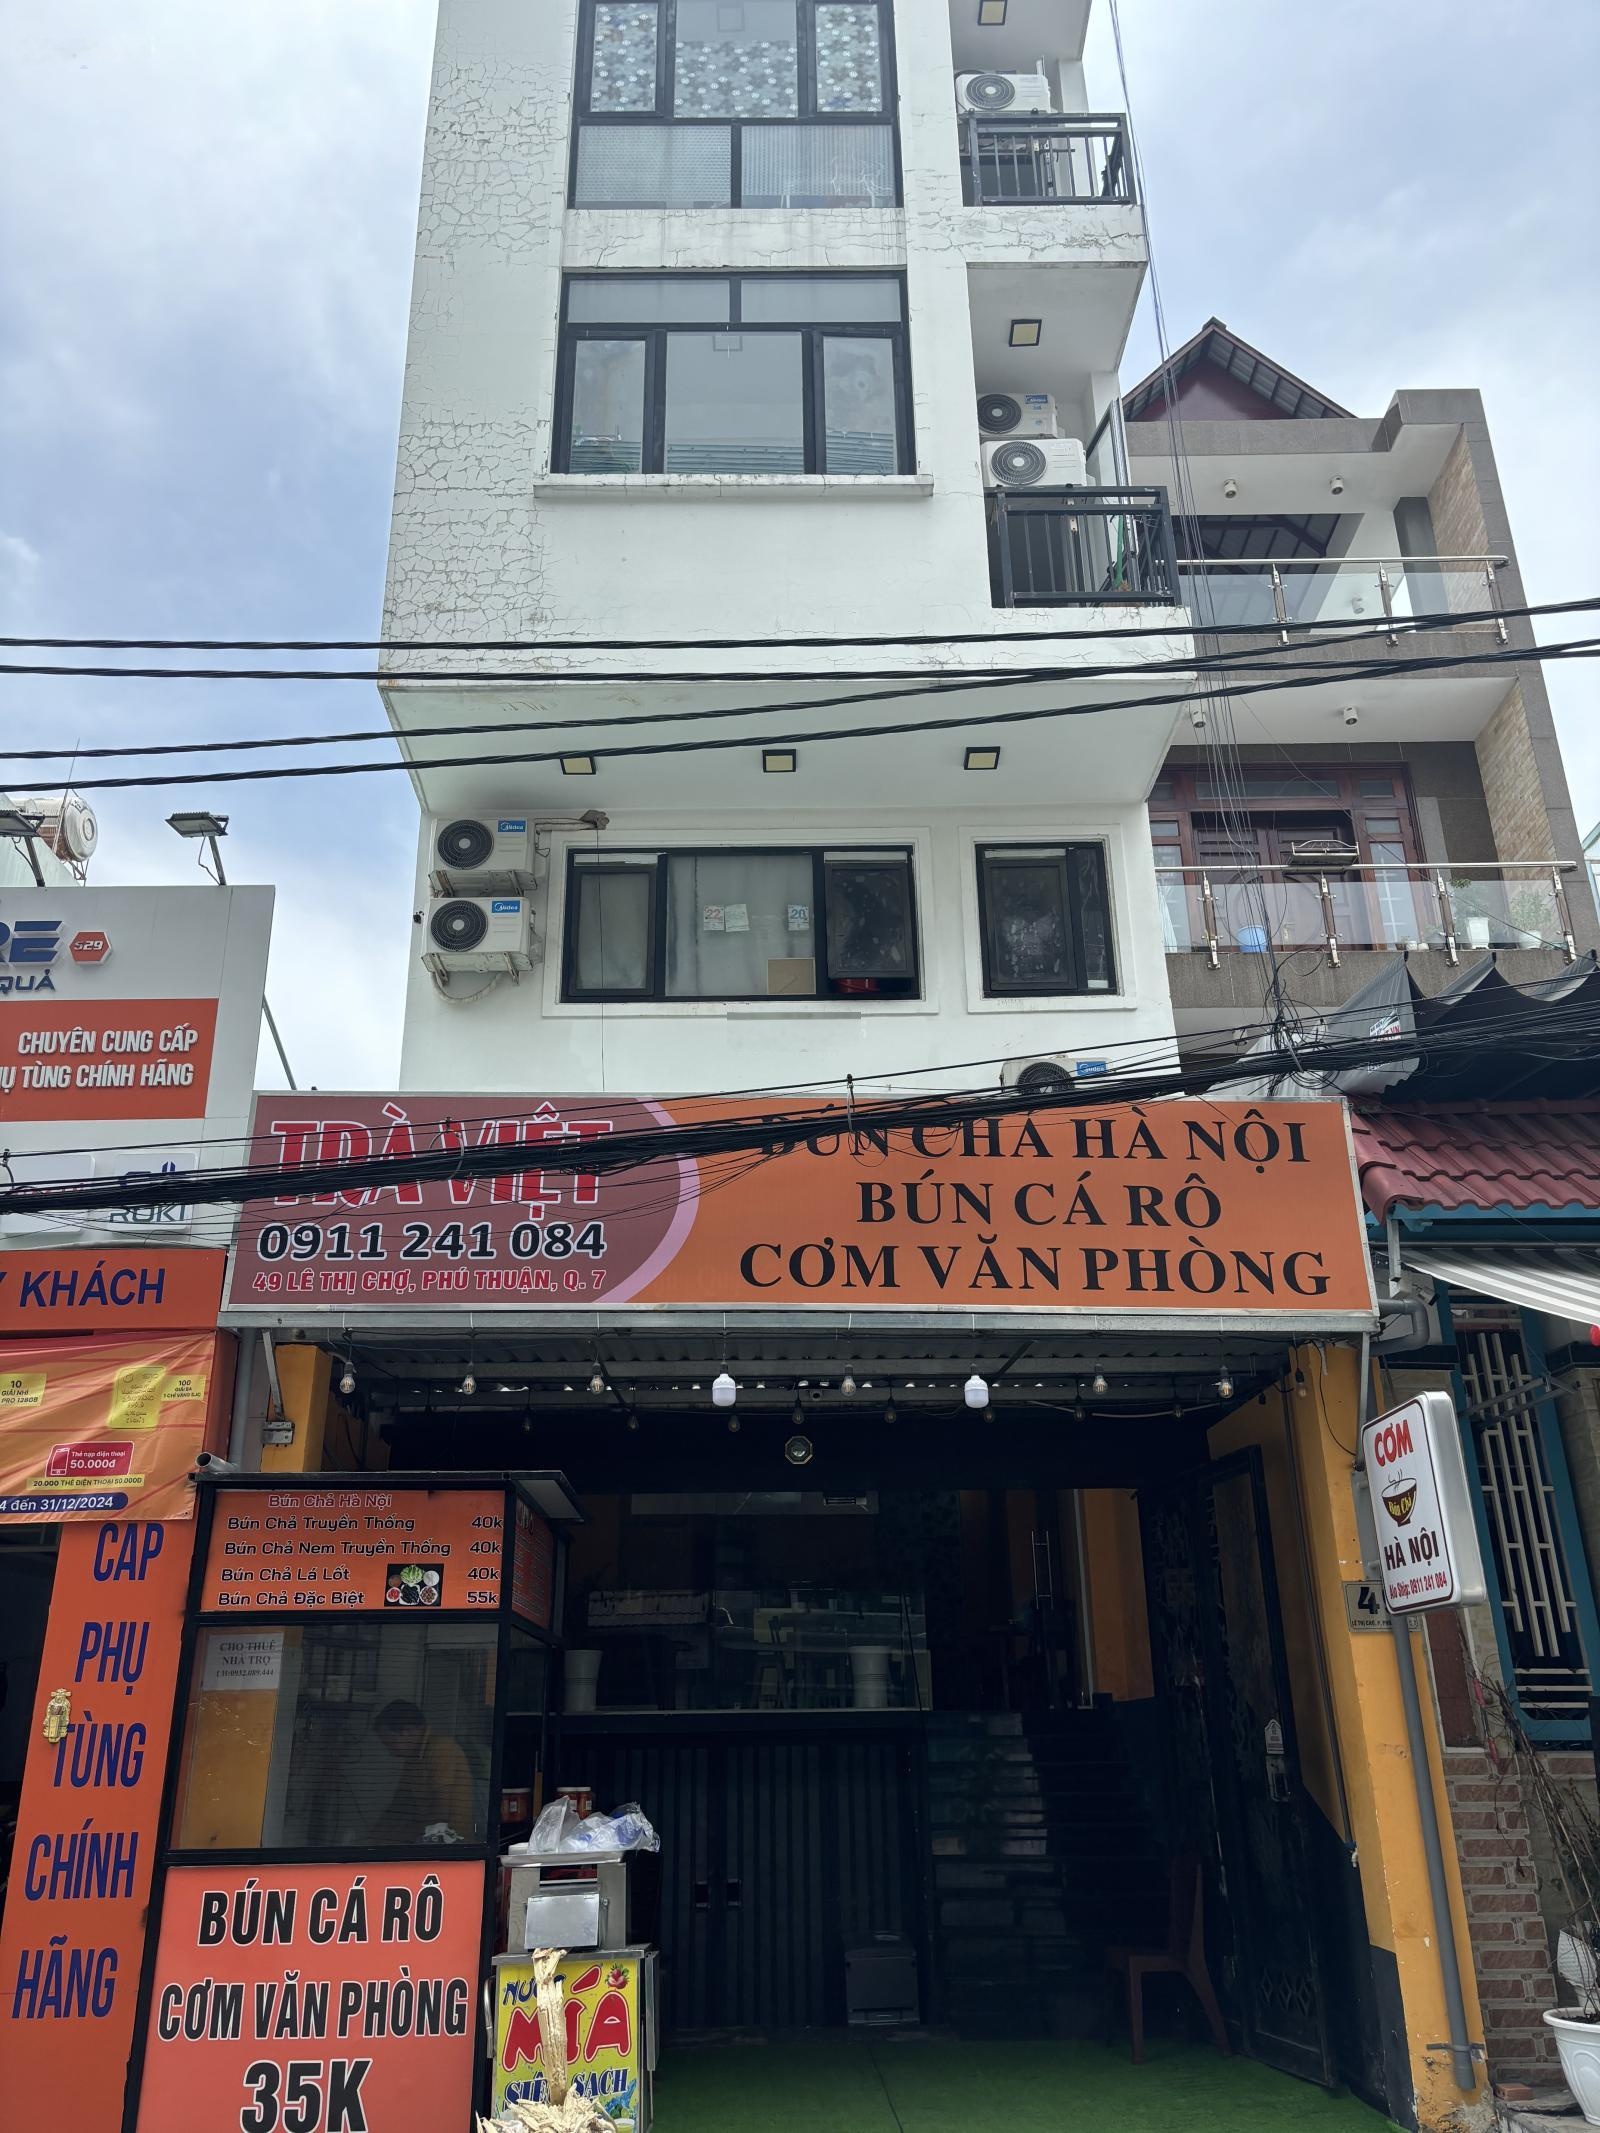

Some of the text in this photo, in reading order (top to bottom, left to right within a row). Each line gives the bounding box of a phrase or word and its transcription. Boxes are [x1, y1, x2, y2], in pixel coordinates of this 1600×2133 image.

[18, 1023, 199, 1054] CHUYÊN CUNG CẤP
[0, 1058, 194, 1093] Ụ TÙNG CHÍNH HÃNG
[1069, 1106, 1168, 1160] HÀ
[1185, 1108, 1312, 1174] NỘI
[271, 1101, 613, 1220] TRÀ VIỆT
[856, 1169, 1221, 1229] BÚN CÁ RÔ
[257, 1222, 607, 1262] 0911 241 084
[253, 1265, 607, 1295] 49 LÊ THỊ CHỢ, PHÚ THUẬN, Q. 7
[739, 1233, 1331, 1297] CƠM VĂN PHÒNG
[19, 1260, 166, 1308] KHÁCH
[11, 1380, 22, 1388] 10
[1374, 1419, 1414, 1467] CƠM
[70, 1459, 116, 1469] 50.000đ
[33, 1479, 59, 1487] 20.000
[268, 1493, 392, 1508] Bún Chả Hà Nội
[11, 1497, 36, 1511] đến
[40, 1496, 114, 1510] 31/12/2024
[227, 1512, 503, 1532] Bún Chả Truyền Thống 40k
[224, 1538, 501, 1557] Bún Chả Nem Truyền Thống 40k
[1384, 1527, 1440, 1570] HÀ NỘI
[221, 1563, 500, 1581] Bún Chả Lá Lốt 40k
[1410, 1578, 1424, 1595] 0911
[1424, 1574, 1435, 1591] 241
[218, 1591, 498, 1607] Bún Chả Đặc Biệt 55k
[74, 1621, 150, 1696] PHỤ
[220, 1642, 244, 1651] CHO
[249, 1656, 271, 1666] TRỌ
[53, 1710, 147, 1788] TÙNG
[24, 1818, 139, 1902] CHÍNH
[198, 1874, 444, 1946] BÚN CÁ RÔ
[11, 1935, 119, 2019] HÃNG
[157, 1965, 469, 2042] CƠM VĂN PHÒNG
[502, 1964, 632, 2073] MÍA
[239, 2057, 374, 2133] 35K
[505, 2071, 552, 2104] SIÊ
